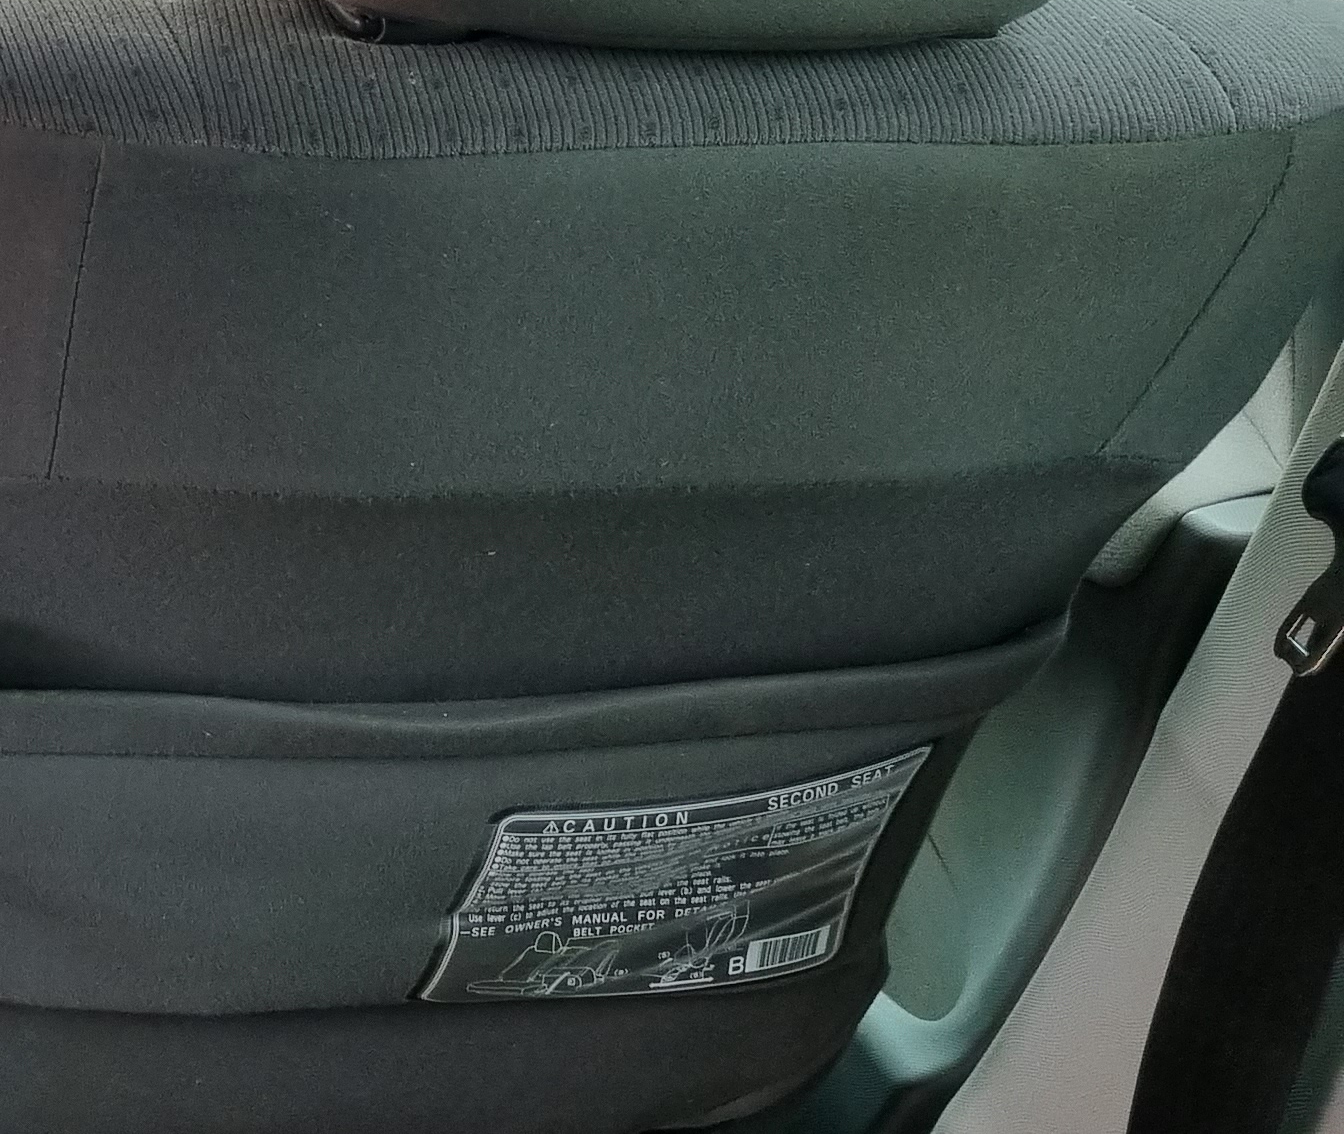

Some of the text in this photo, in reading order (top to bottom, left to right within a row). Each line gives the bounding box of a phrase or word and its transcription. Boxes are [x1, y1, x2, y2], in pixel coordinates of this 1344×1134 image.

[767, 764, 895, 811] SECOND SEAT
[562, 811, 689, 833] CAUTION
[468, 914, 483, 923] Use
[487, 914, 506, 922] lever
[505, 916, 563, 934] OWNER'S
[572, 911, 628, 926] MANUAL
[637, 909, 666, 921] FOR
[573, 922, 655, 937] BELT POCKET
[728, 956, 745, 975] B
